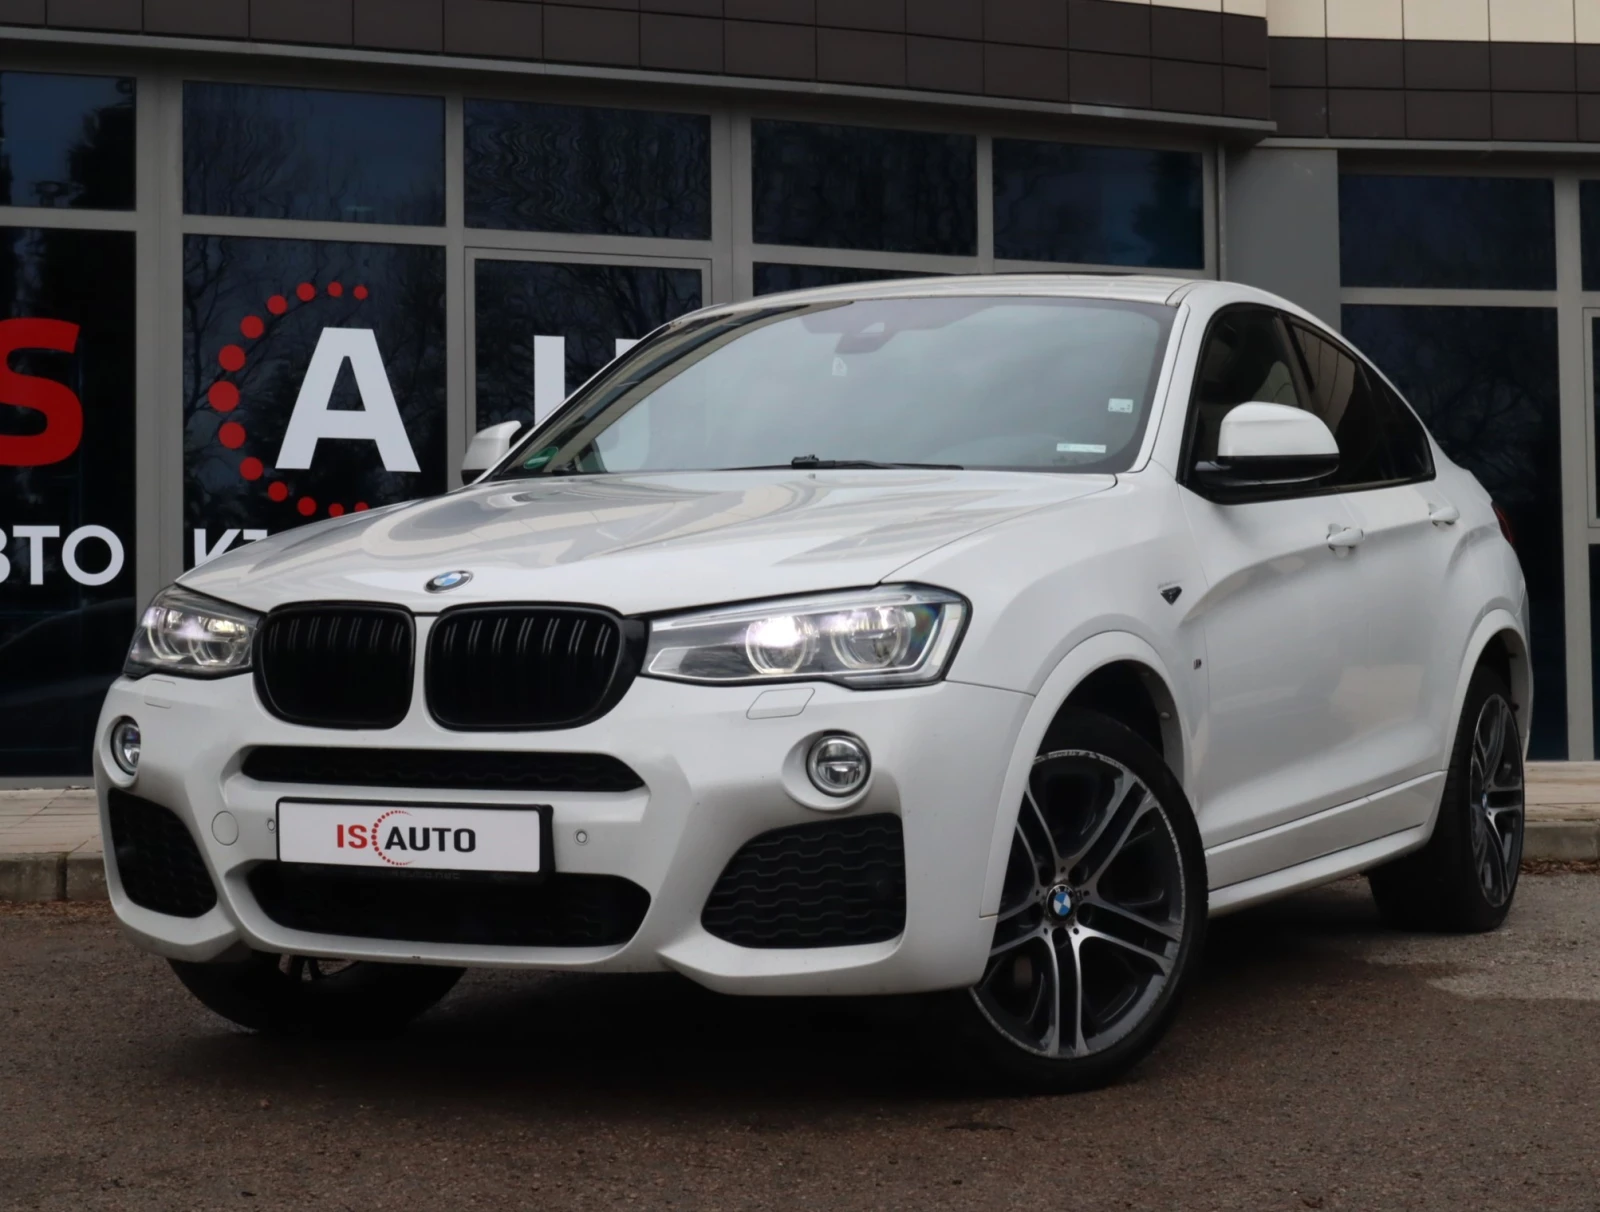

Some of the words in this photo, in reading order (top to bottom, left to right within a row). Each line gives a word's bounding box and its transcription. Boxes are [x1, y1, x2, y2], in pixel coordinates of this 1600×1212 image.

[0, 524, 125, 586] ТО
[336, 823, 368, 849] IS
[384, 826, 476, 853] AUTO
